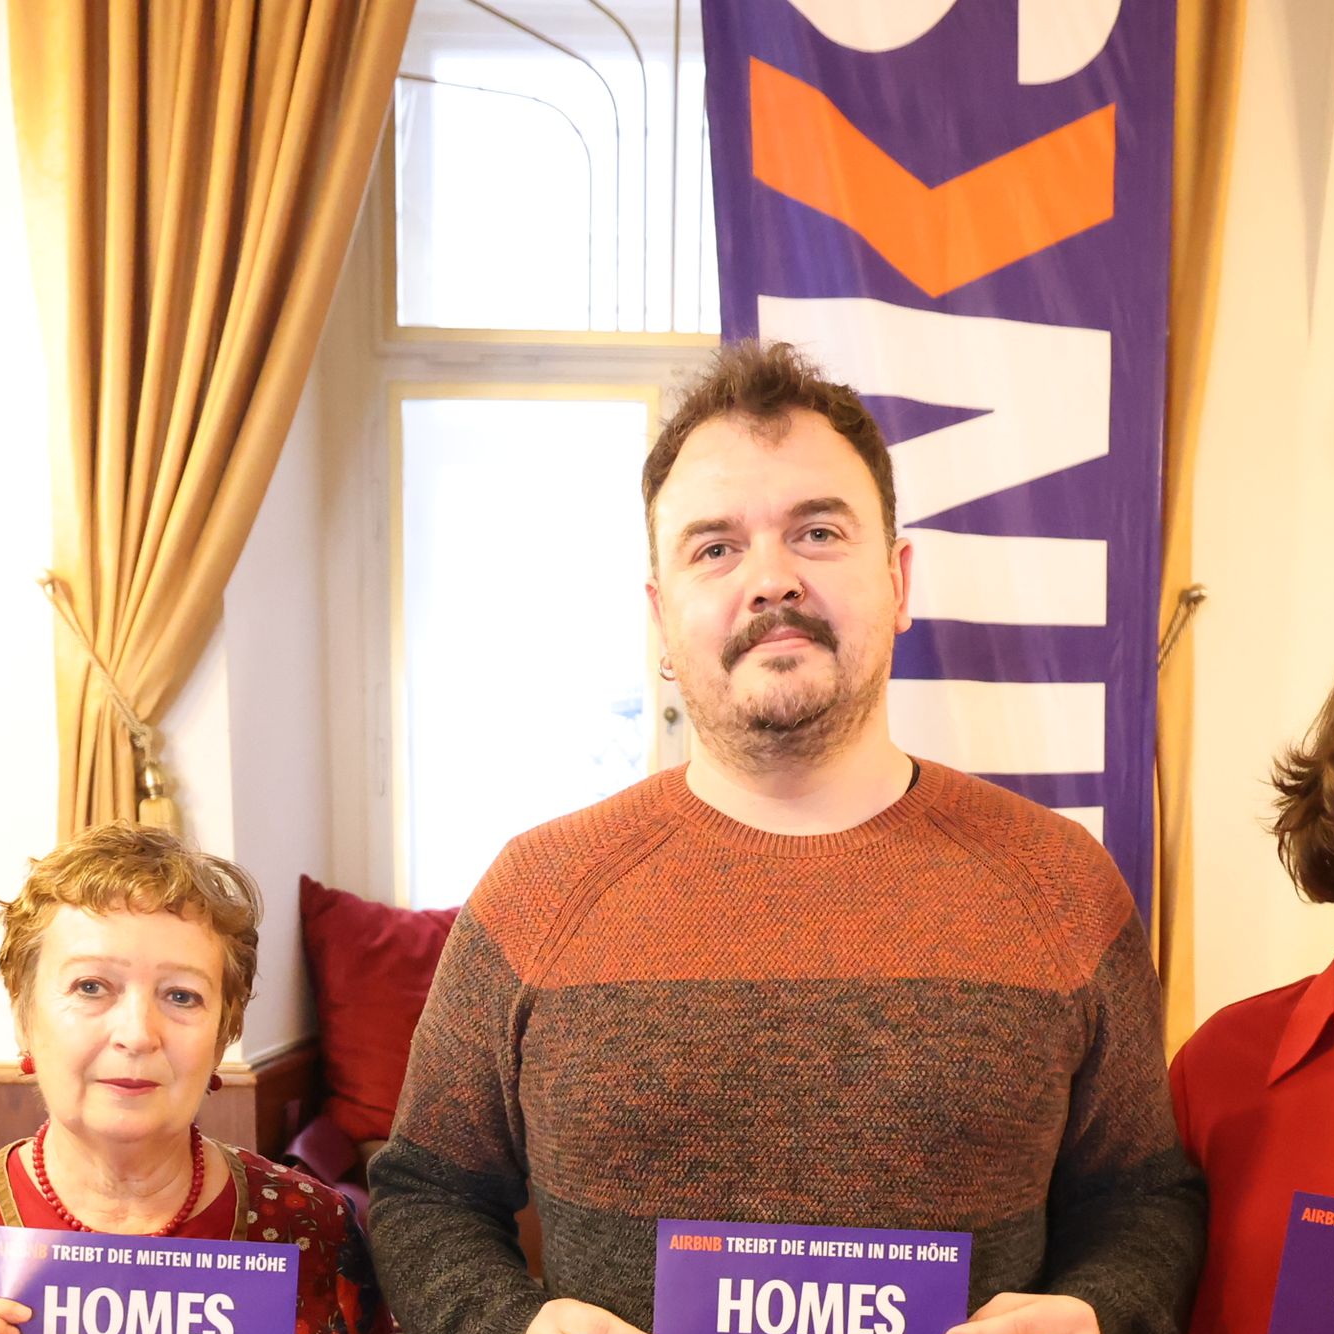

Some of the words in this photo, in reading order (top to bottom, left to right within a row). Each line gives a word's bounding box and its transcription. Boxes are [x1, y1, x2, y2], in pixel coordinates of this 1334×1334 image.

[52, 1244, 103, 1264] TREIBT
[108, 1249, 132, 1266] DIE
[136, 1250, 191, 1269] MIETEN
[196, 1253, 212, 1269] IN
[216, 1253, 240, 1271] DIE
[244, 1252, 287, 1273] HÖHE
[670, 1234, 722, 1252] AIRBNB
[726, 1237, 777, 1255] TREIBT
[781, 1239, 805, 1256] DIE
[809, 1240, 864, 1259] MIETEN
[868, 1243, 884, 1260] IN
[888, 1244, 913, 1261] DIE
[916, 1243, 959, 1263] HÖHE
